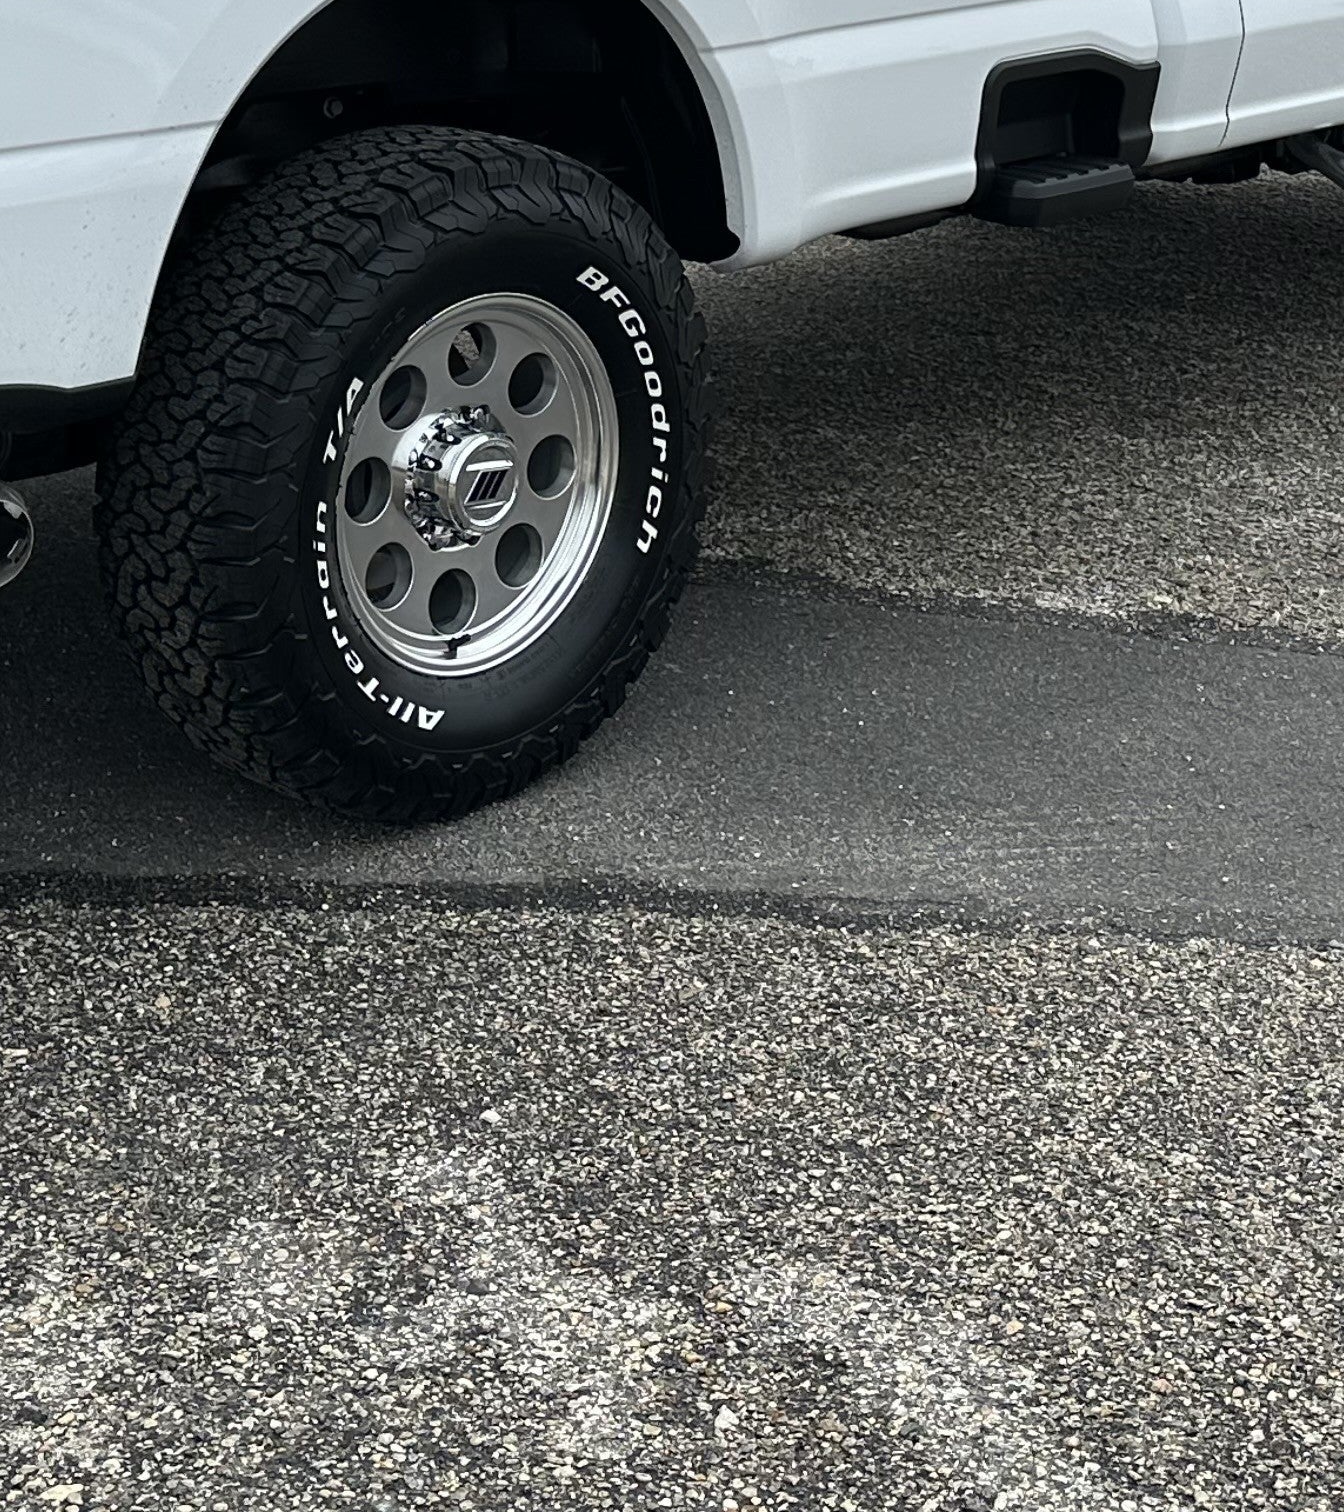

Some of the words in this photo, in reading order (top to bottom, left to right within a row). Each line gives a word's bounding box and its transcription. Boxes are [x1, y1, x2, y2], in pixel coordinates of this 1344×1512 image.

[322, 376, 364, 465] T/A
[575, 266, 671, 554] BFGoodrich
[313, 501, 445, 731] All-Terrain
